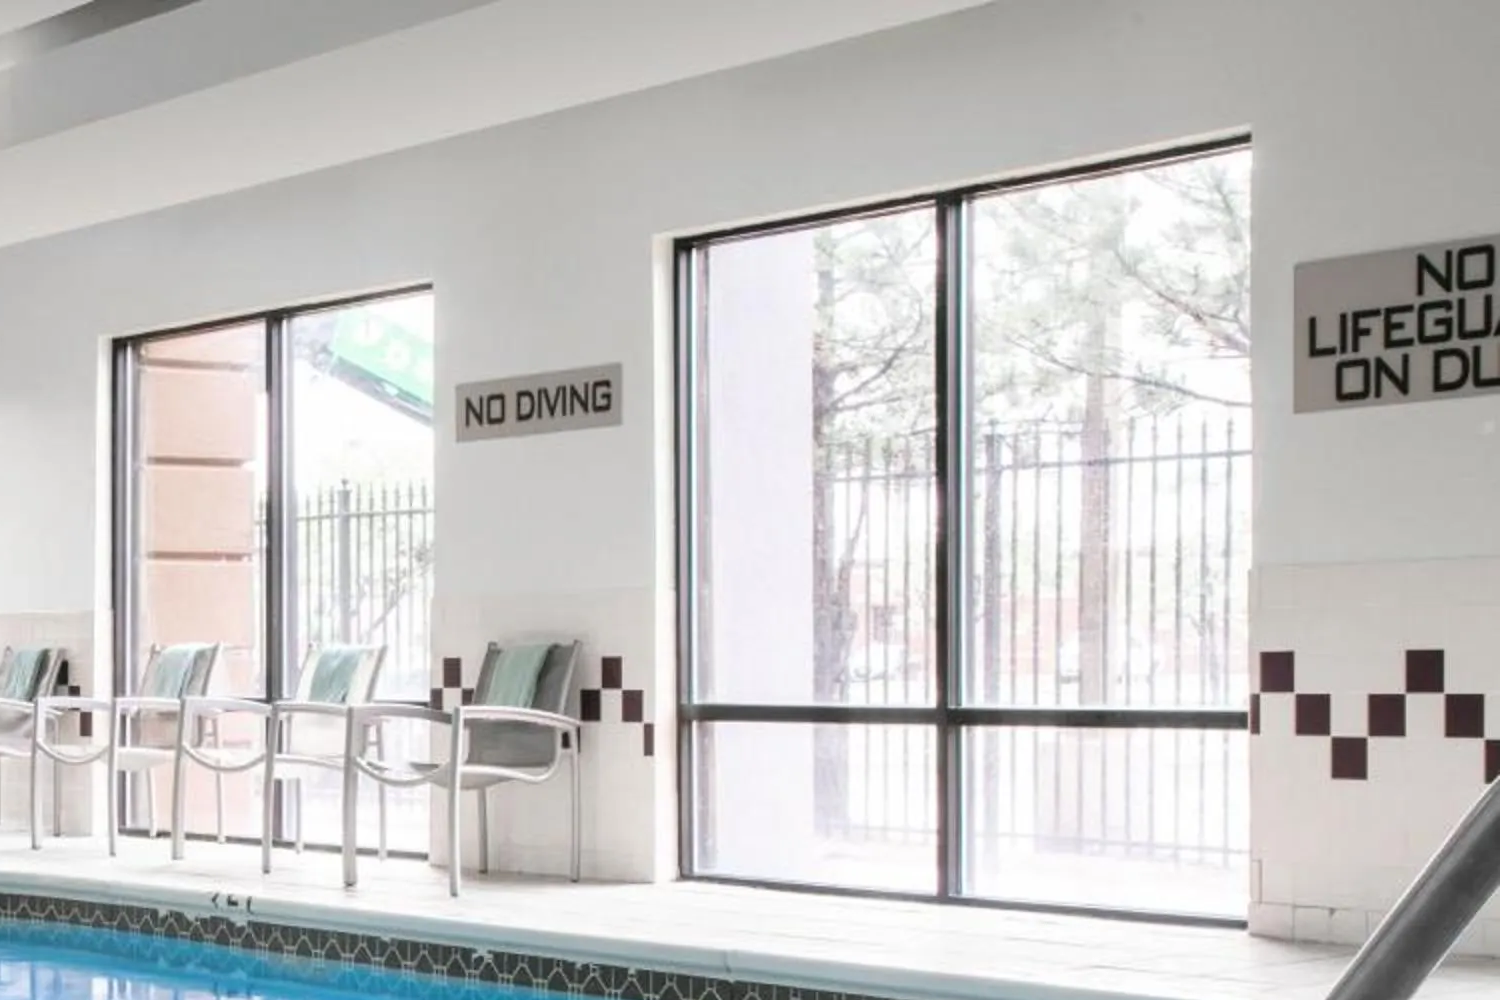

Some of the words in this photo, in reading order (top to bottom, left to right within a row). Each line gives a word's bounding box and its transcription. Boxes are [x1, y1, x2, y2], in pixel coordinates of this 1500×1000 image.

[1416, 244, 1495, 297] NO
[1308, 294, 1500, 358] LIFEGU
[465, 393, 506, 427] NO
[515, 379, 612, 422] DIVING
[1336, 353, 1409, 403] ON
